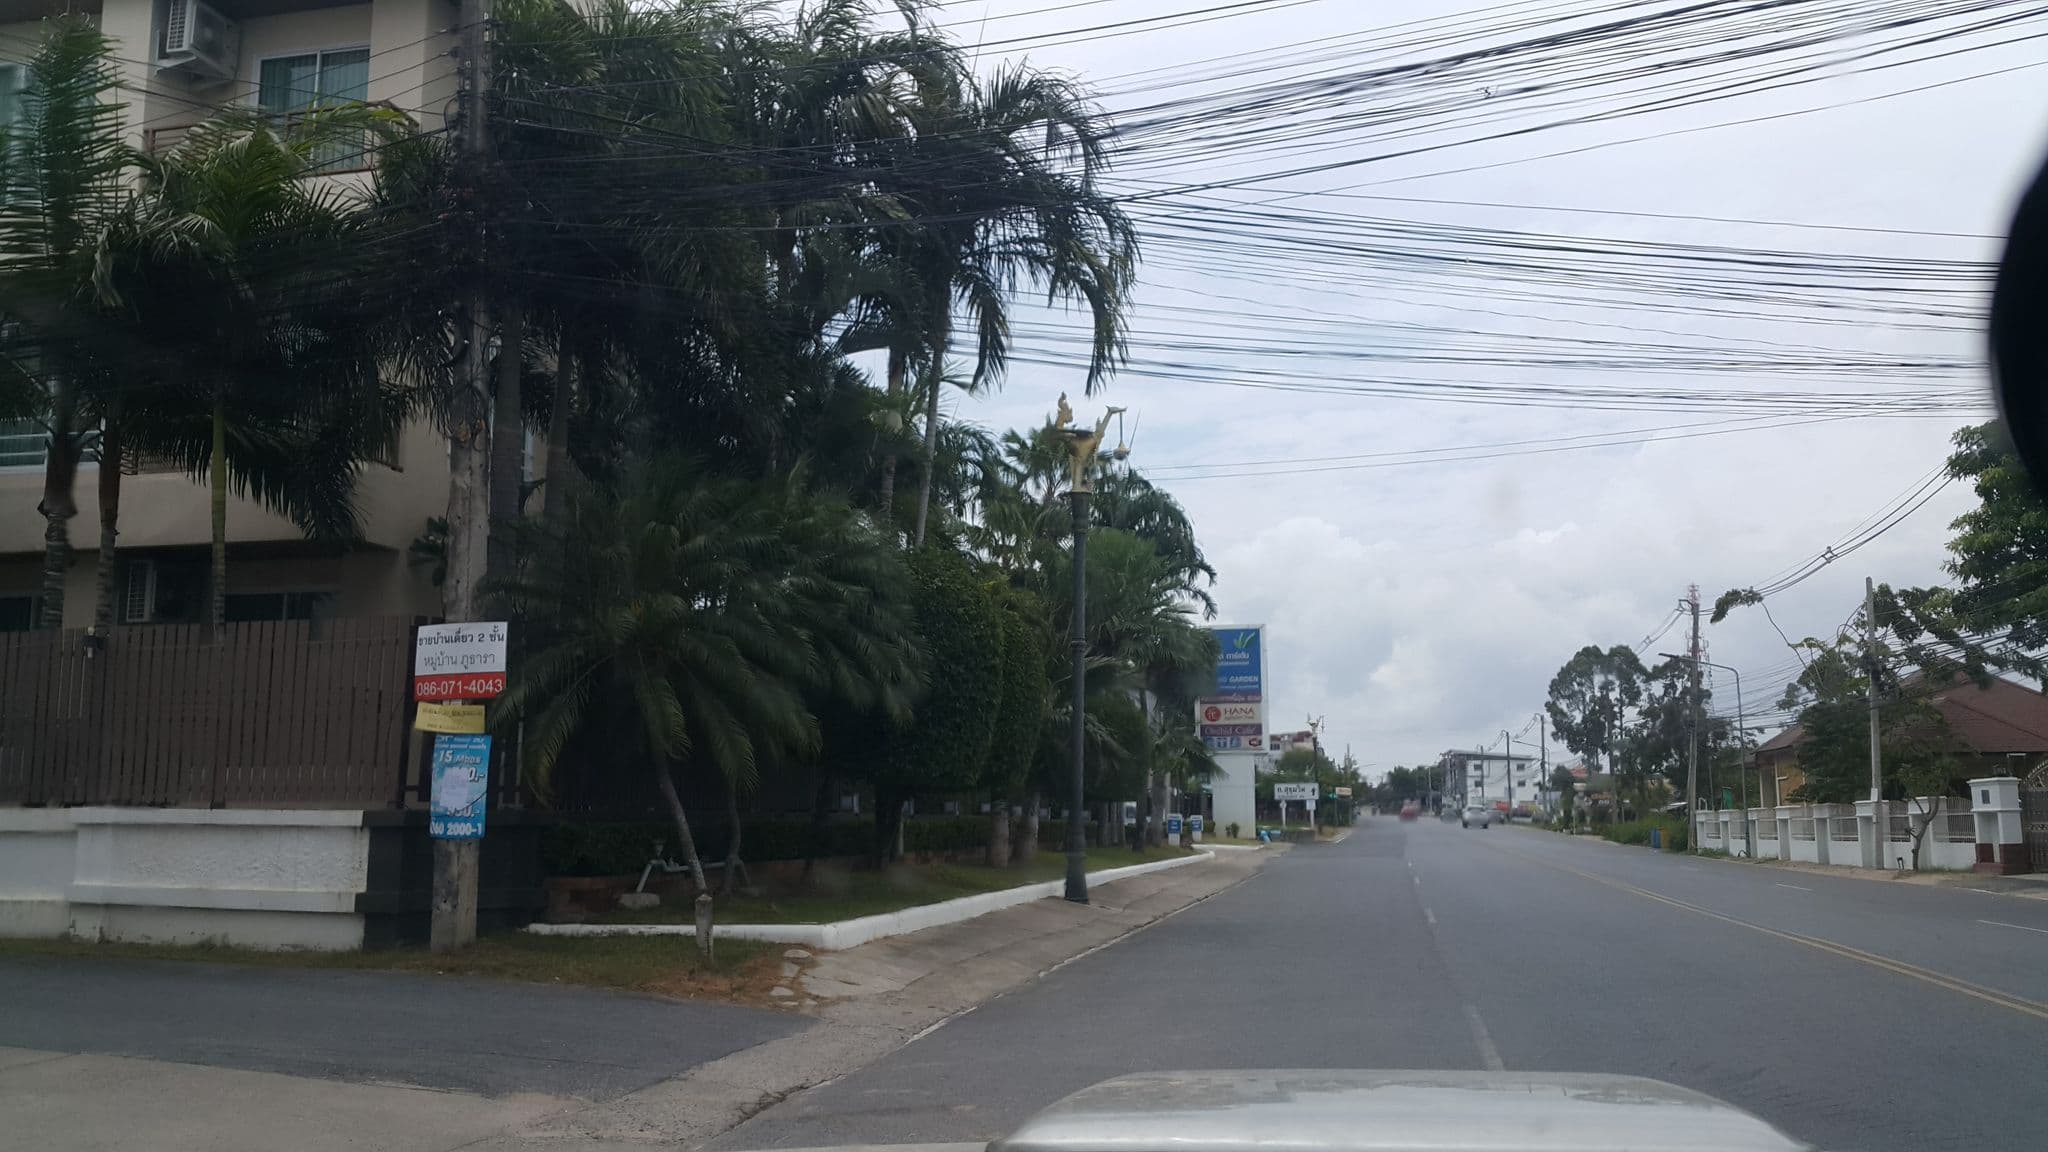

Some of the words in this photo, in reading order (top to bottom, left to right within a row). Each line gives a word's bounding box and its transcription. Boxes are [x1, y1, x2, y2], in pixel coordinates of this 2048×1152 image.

[418, 627, 474, 646] ขายบ้านเดี่ยว
[477, 632, 485, 642] 2
[489, 625, 504, 642] ชั้น
[423, 650, 458, 671] หมู่บ้าน
[416, 679, 503, 696] 086-071-4043
[1224, 707, 1255, 715] HANA
[439, 750, 454, 763] 15
